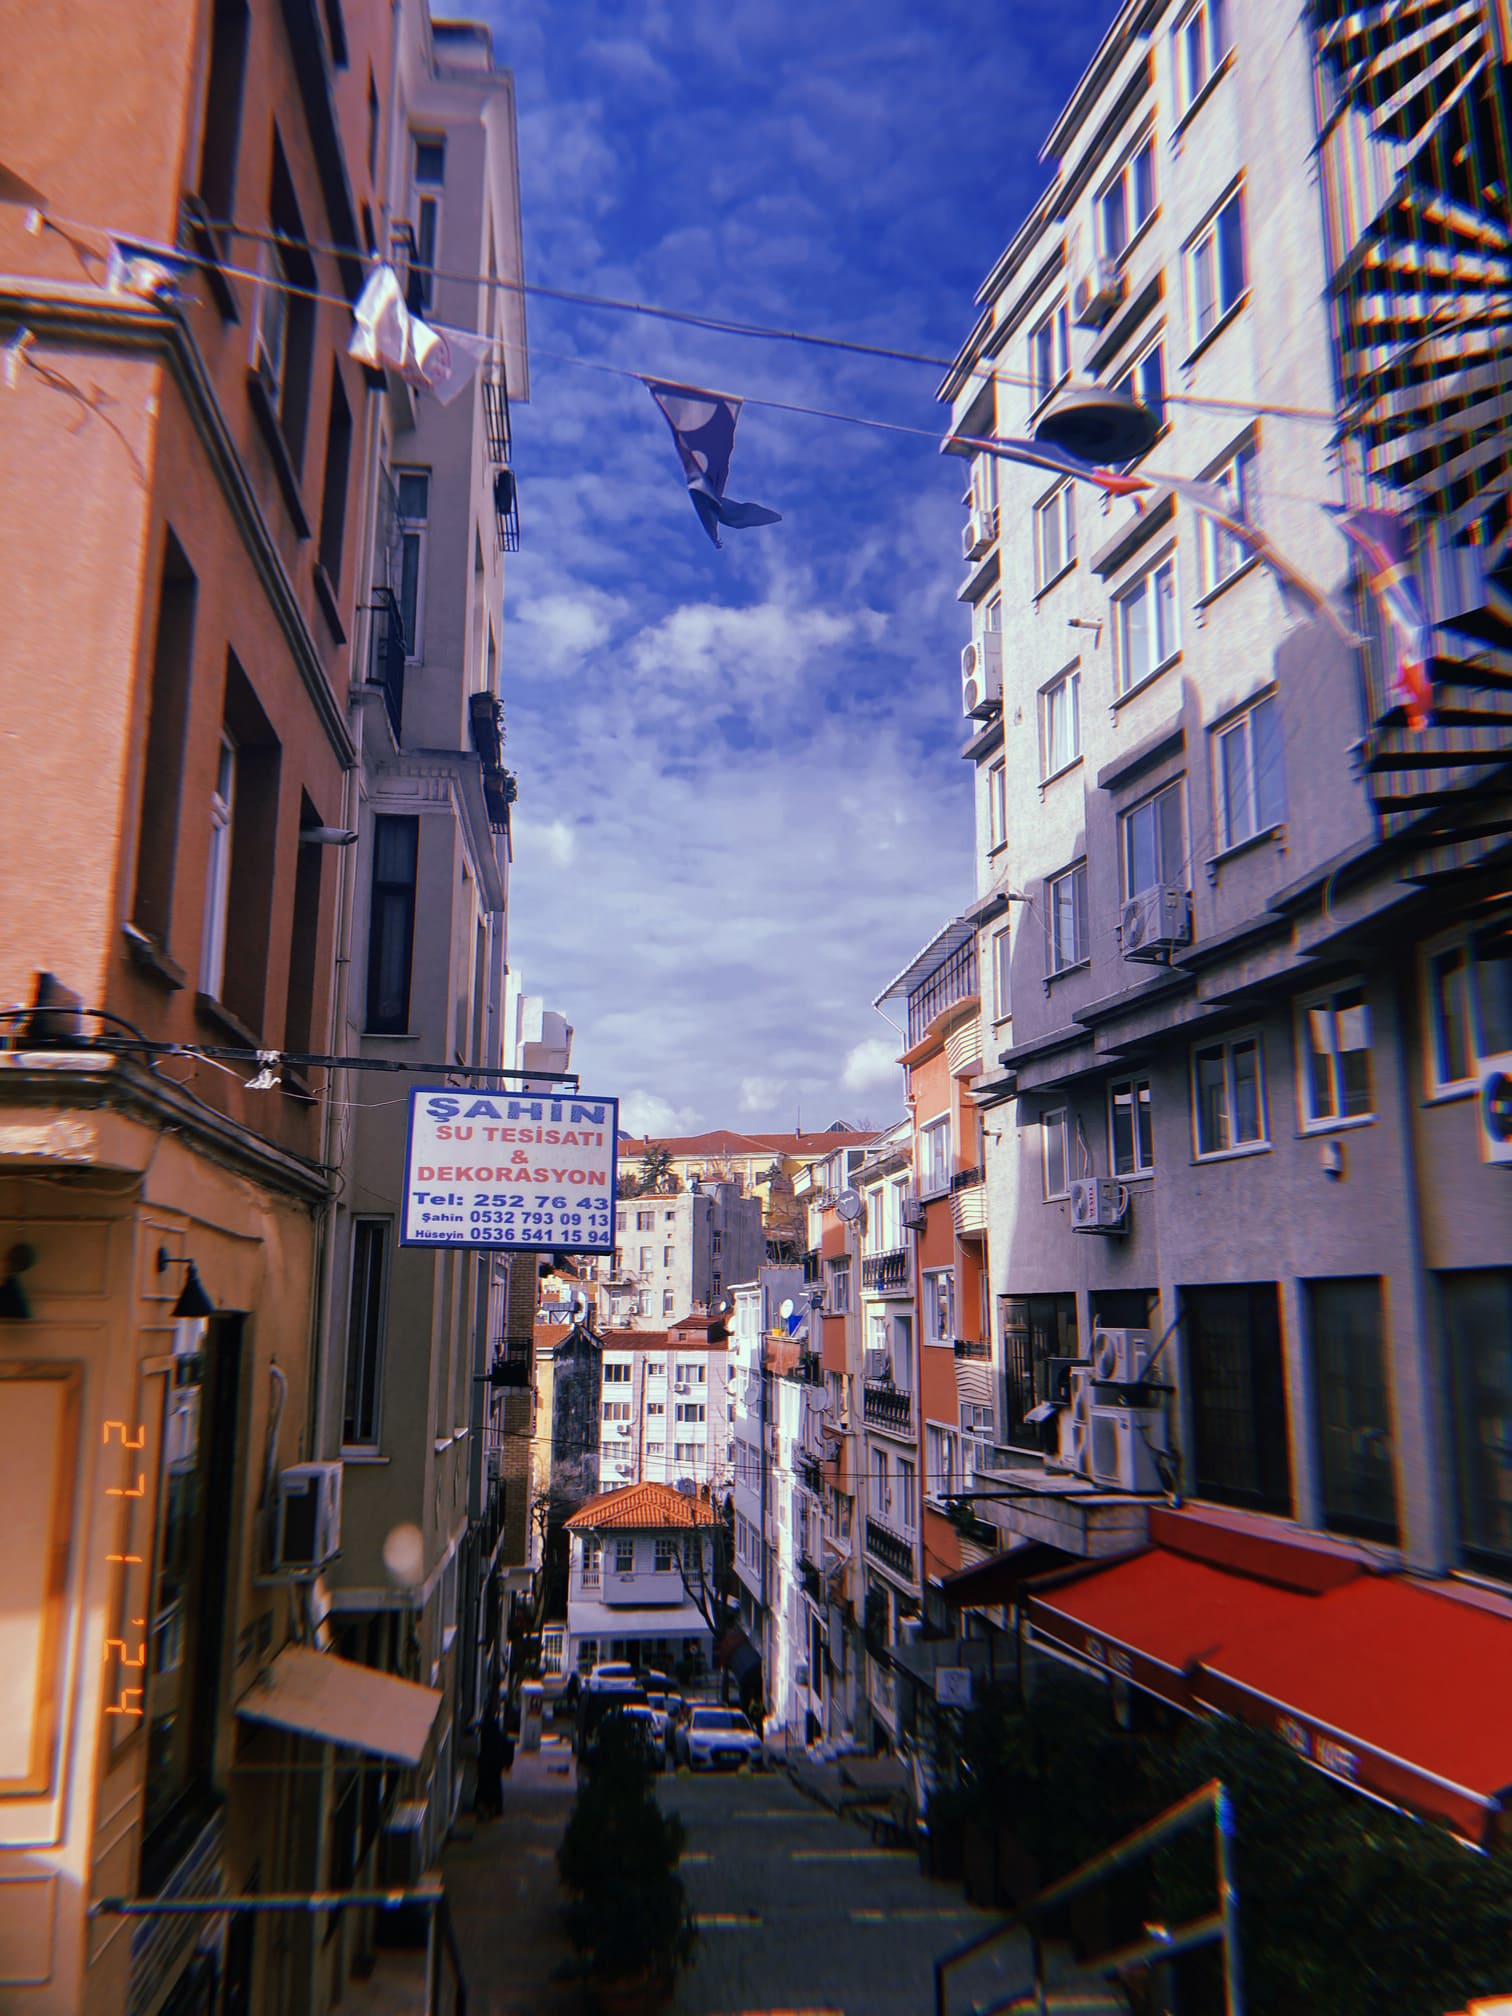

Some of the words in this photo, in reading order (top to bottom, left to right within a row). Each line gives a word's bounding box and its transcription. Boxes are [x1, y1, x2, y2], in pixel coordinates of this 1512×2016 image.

[426, 1098, 605, 1124] ŞAHİN
[436, 1125, 472, 1140] SU
[483, 1126, 603, 1146] TESİSATI
[510, 1150, 528, 1164] &
[418, 1166, 606, 1185] DEKORASYON
[413, 1192, 464, 1205] Tel:
[473, 1194, 524, 1207] 252
[534, 1196, 567, 1209] 76
[576, 1197, 609, 1210] 43
[421, 1212, 464, 1223] Şahin
[470, 1211, 514, 1224] 0532
[521, 1212, 553, 1225] 793
[560, 1213, 581, 1225] 09
[588, 1214, 609, 1227] 13
[416, 1230, 464, 1241] Hüseyin
[470, 1227, 515, 1241] 0536
[521, 1229, 553, 1242] 541
[560, 1230, 581, 1242] 15
[588, 1231, 609, 1243] 94
